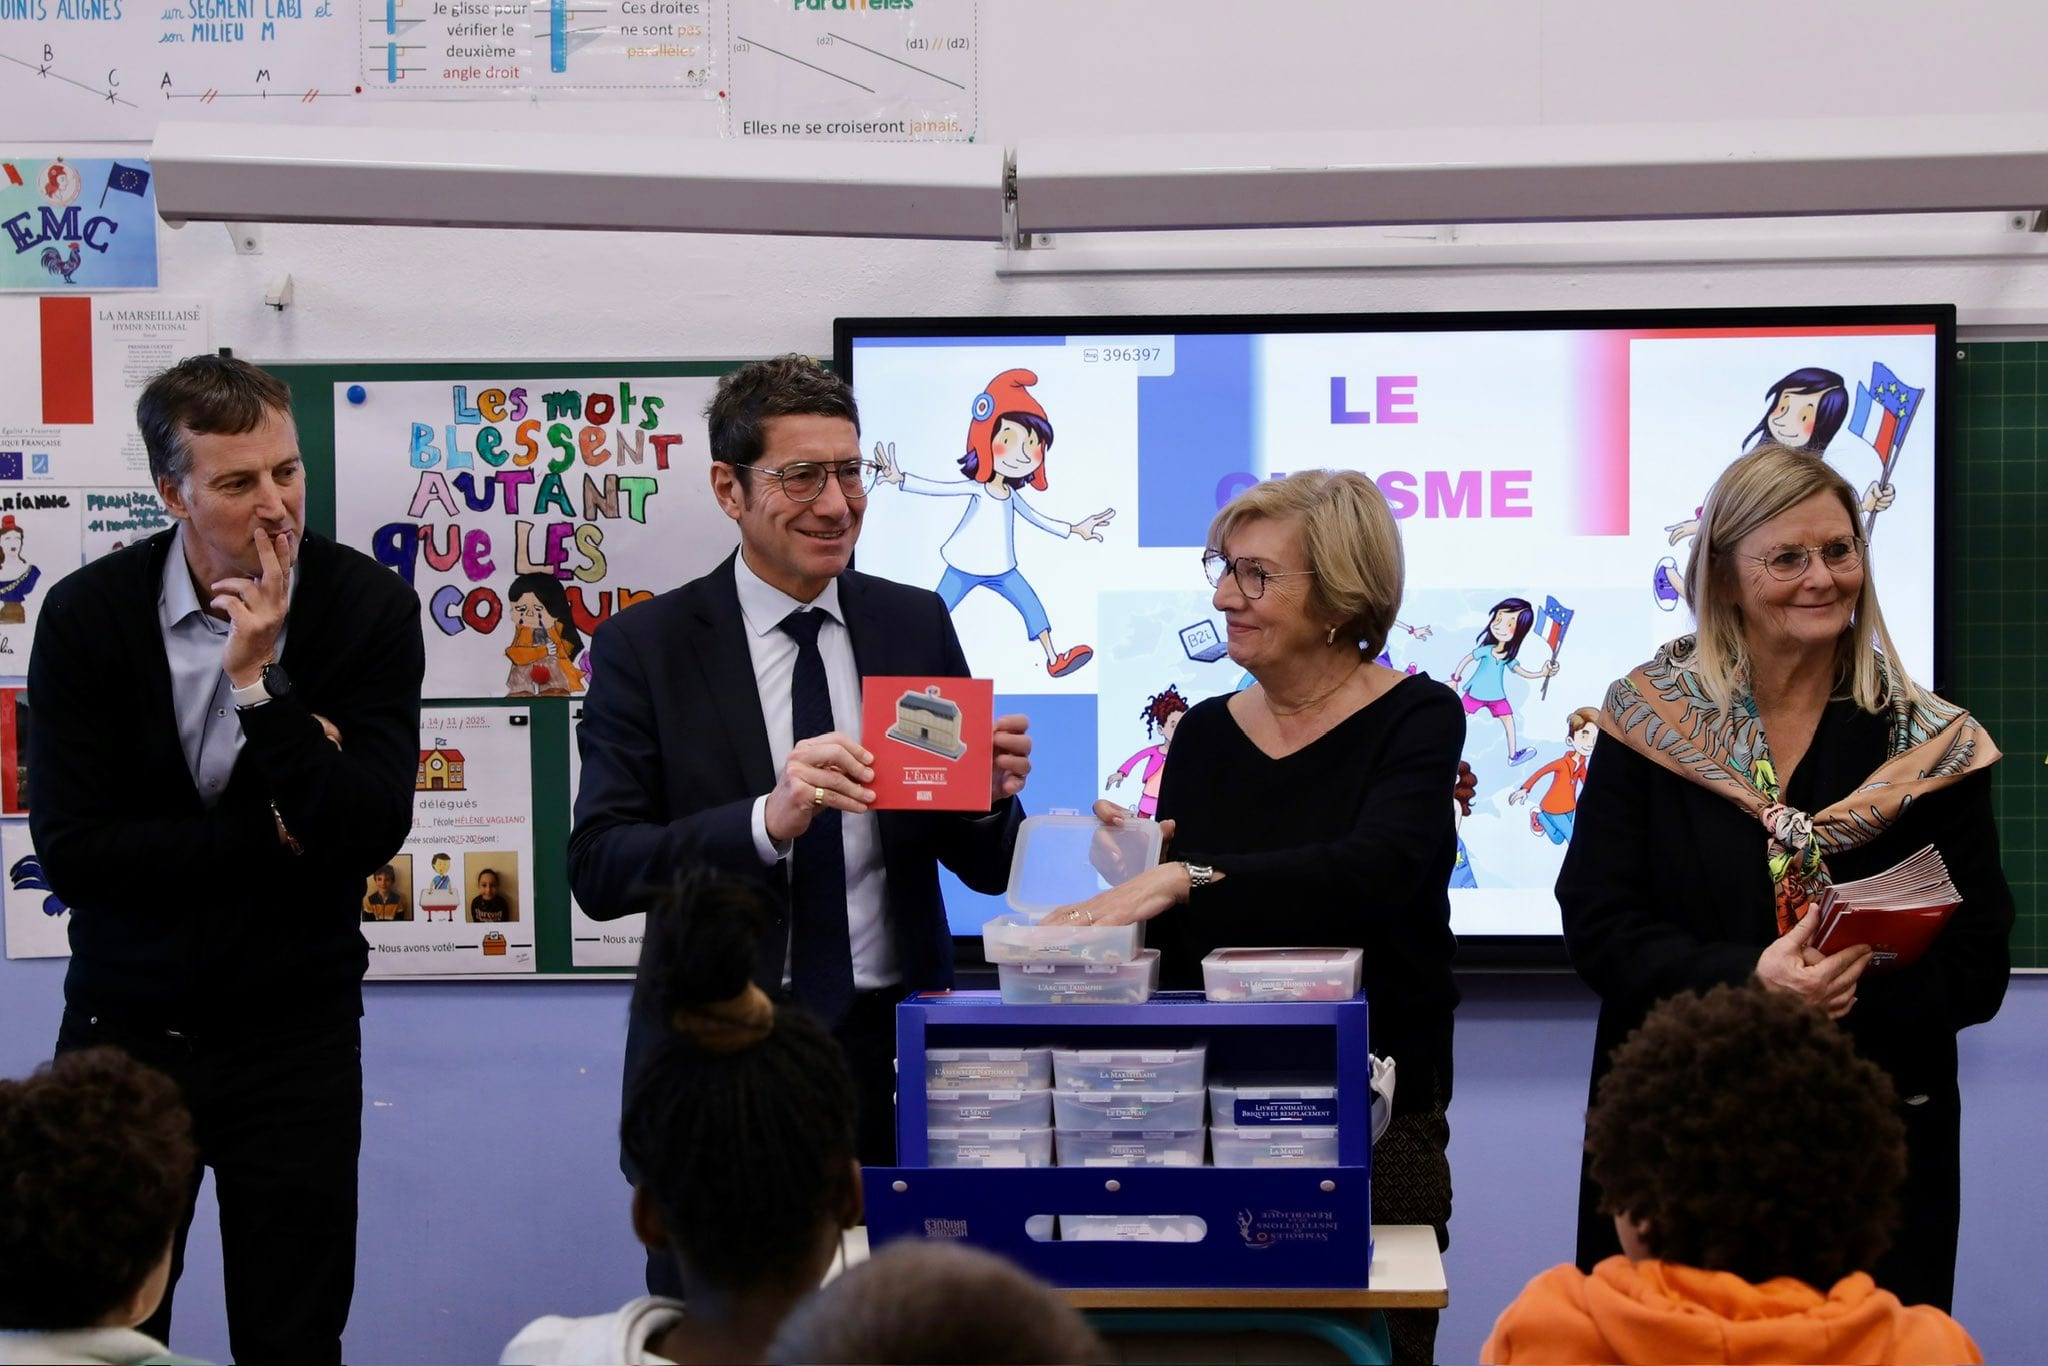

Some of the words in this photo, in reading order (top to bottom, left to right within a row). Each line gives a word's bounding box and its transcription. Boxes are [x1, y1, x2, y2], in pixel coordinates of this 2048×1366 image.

[433, 1, 447, 15] Je
[451, 1, 489, 17] glisse
[495, 4, 527, 16] pour
[621, 1, 646, 14] Ces
[650, 0, 700, 14] droites
[261, 22, 275, 41] M
[447, 23, 498, 36] vérifier
[502, 23, 514, 36] le
[621, 26, 638, 36] ne
[642, 24, 673, 36] sont
[678, 26, 702, 38] pas
[817, 36, 834, 46] (d2)
[906, 38, 929, 51] (d1)
[946, 38, 970, 50] (d2)
[43, 43, 53, 61] B
[446, 44, 516, 57] deuxième
[733, 44, 750, 53] (d1)
[108, 69, 119, 87] C
[256, 69, 271, 82] M
[443, 66, 481, 81] angle
[485, 65, 520, 79] droit
[161, 72, 173, 89] A
[743, 121, 777, 135] Elles
[782, 124, 800, 135] ne
[806, 124, 822, 134] se
[826, 120, 904, 134] croiseront
[2, 205, 118, 254] EMC
[99, 311, 114, 321] LA
[118, 311, 201, 321] MARSEILLAISE
[113, 323, 141, 331] HYMNE
[145, 323, 187, 331] NATIONAL
[1103, 348, 1160, 361] 396397
[1330, 376, 1418, 424] LE
[407, 468, 658, 524] AUTANT
[447, 717, 456, 725] 11
[466, 716, 486, 725] 2025
[419, 799, 478, 811] délégués
[486, 815, 525, 825] VAGLIANO
[603, 935, 627, 944] Nous
[378, 944, 400, 953] Nous
[403, 944, 430, 953] avons
